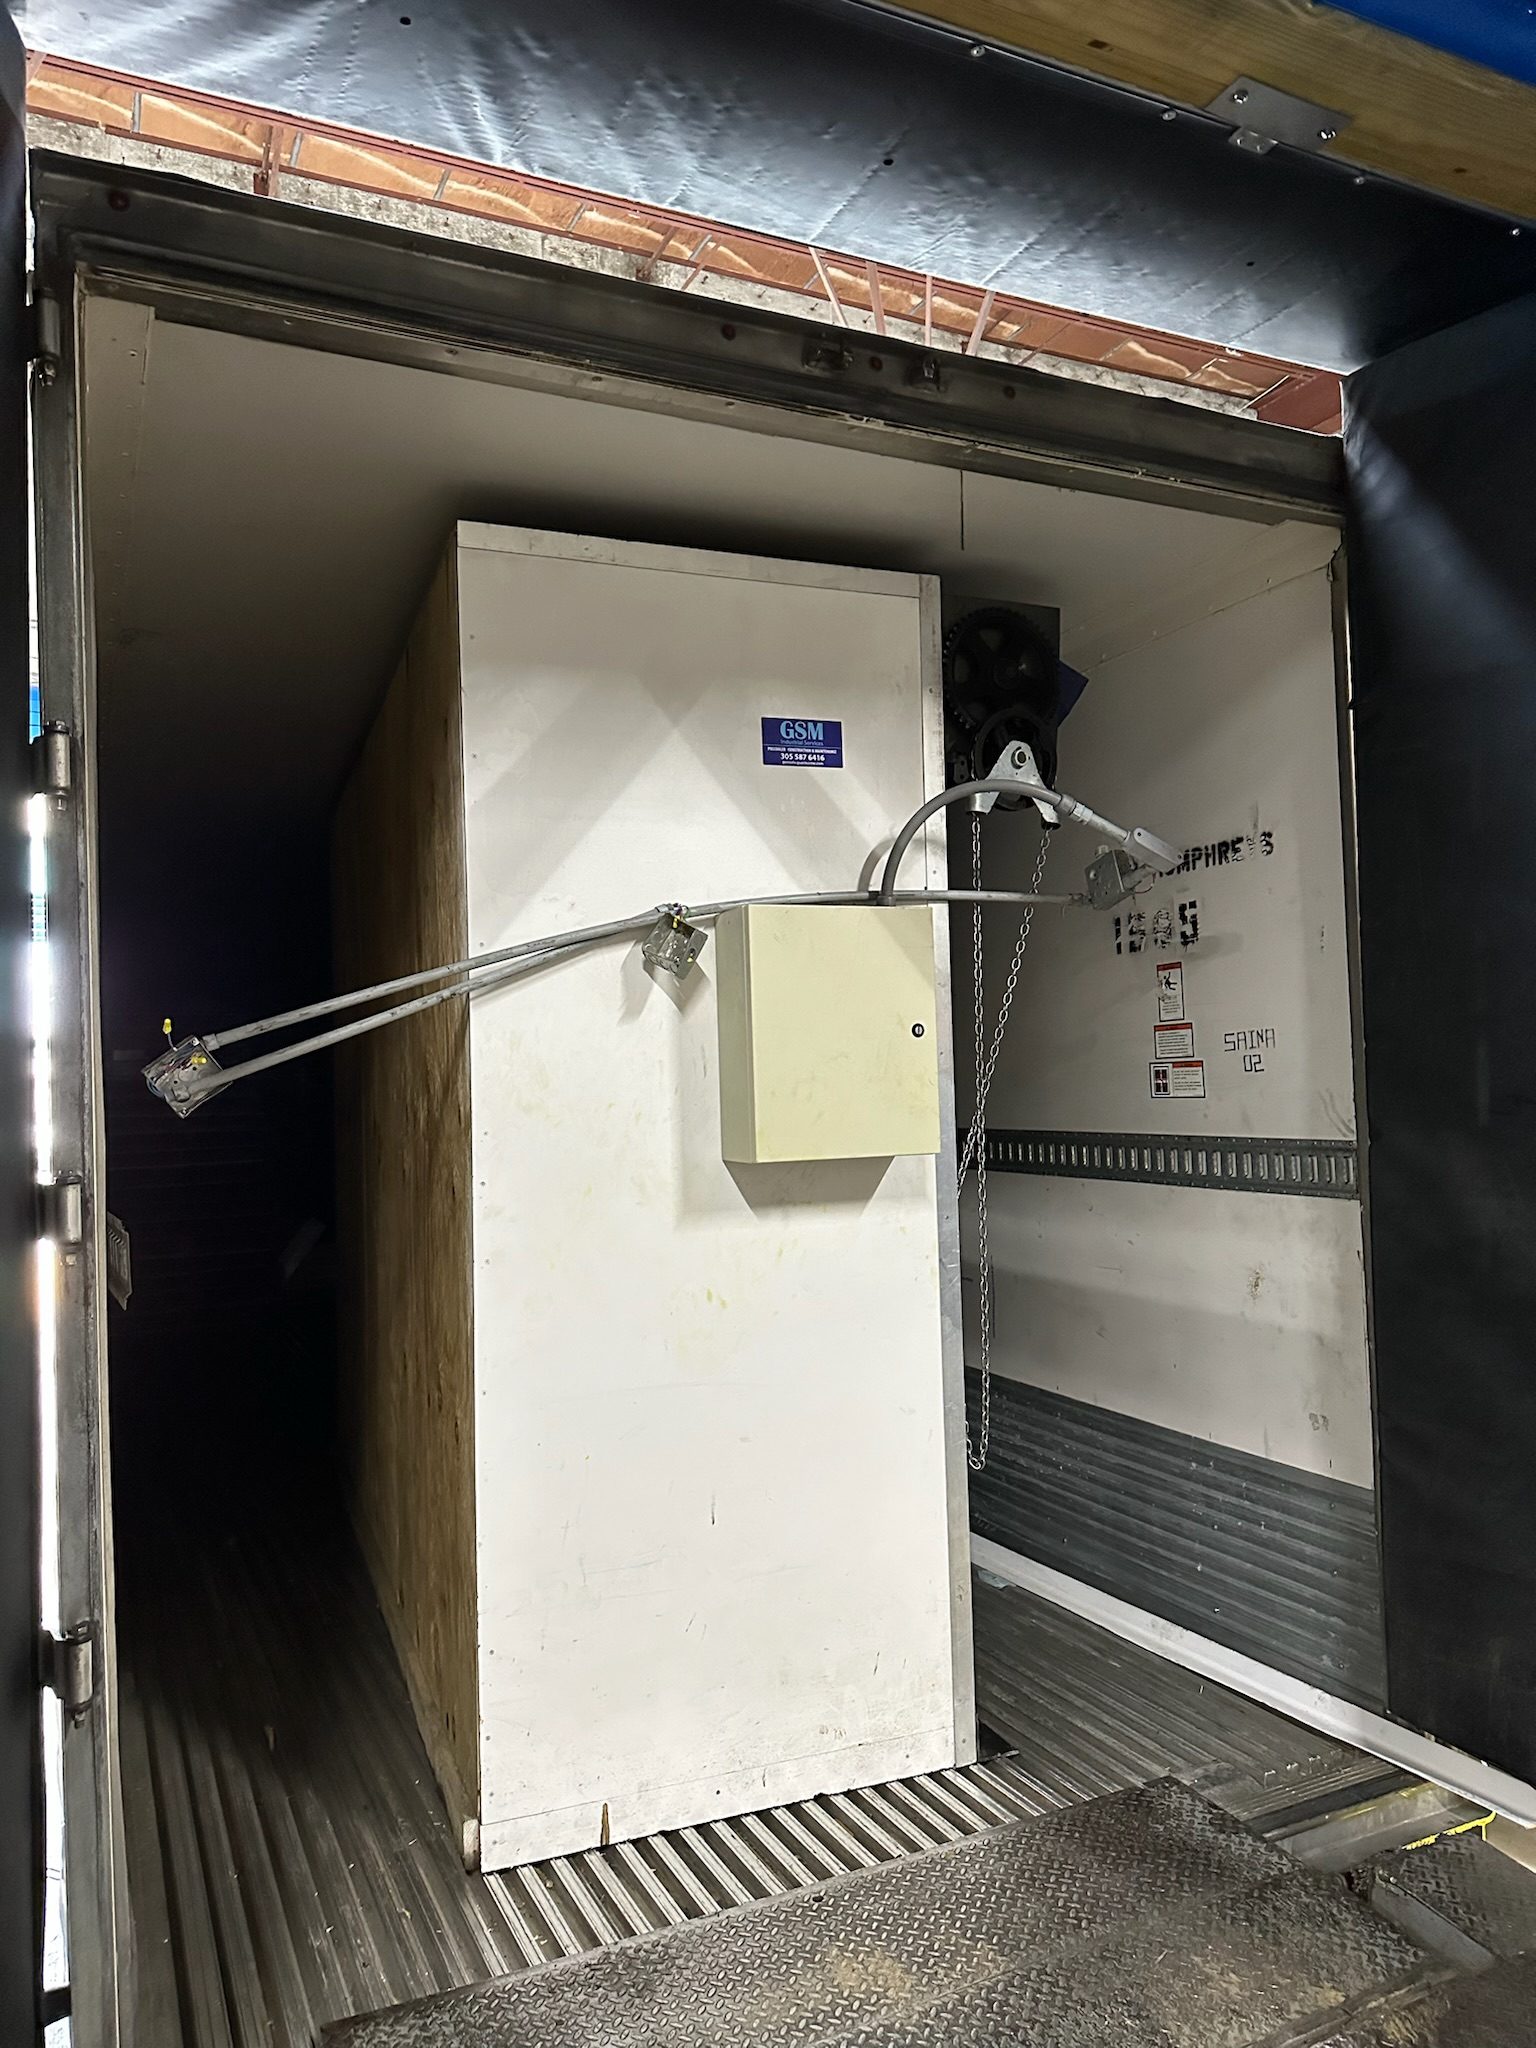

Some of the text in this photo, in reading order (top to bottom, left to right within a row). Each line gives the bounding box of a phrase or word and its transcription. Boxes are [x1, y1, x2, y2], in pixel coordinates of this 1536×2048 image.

[780, 720, 824, 740] GSM
[1224, 1028, 1276, 1052] SAINA
[1243, 1054, 1265, 1072] 02
